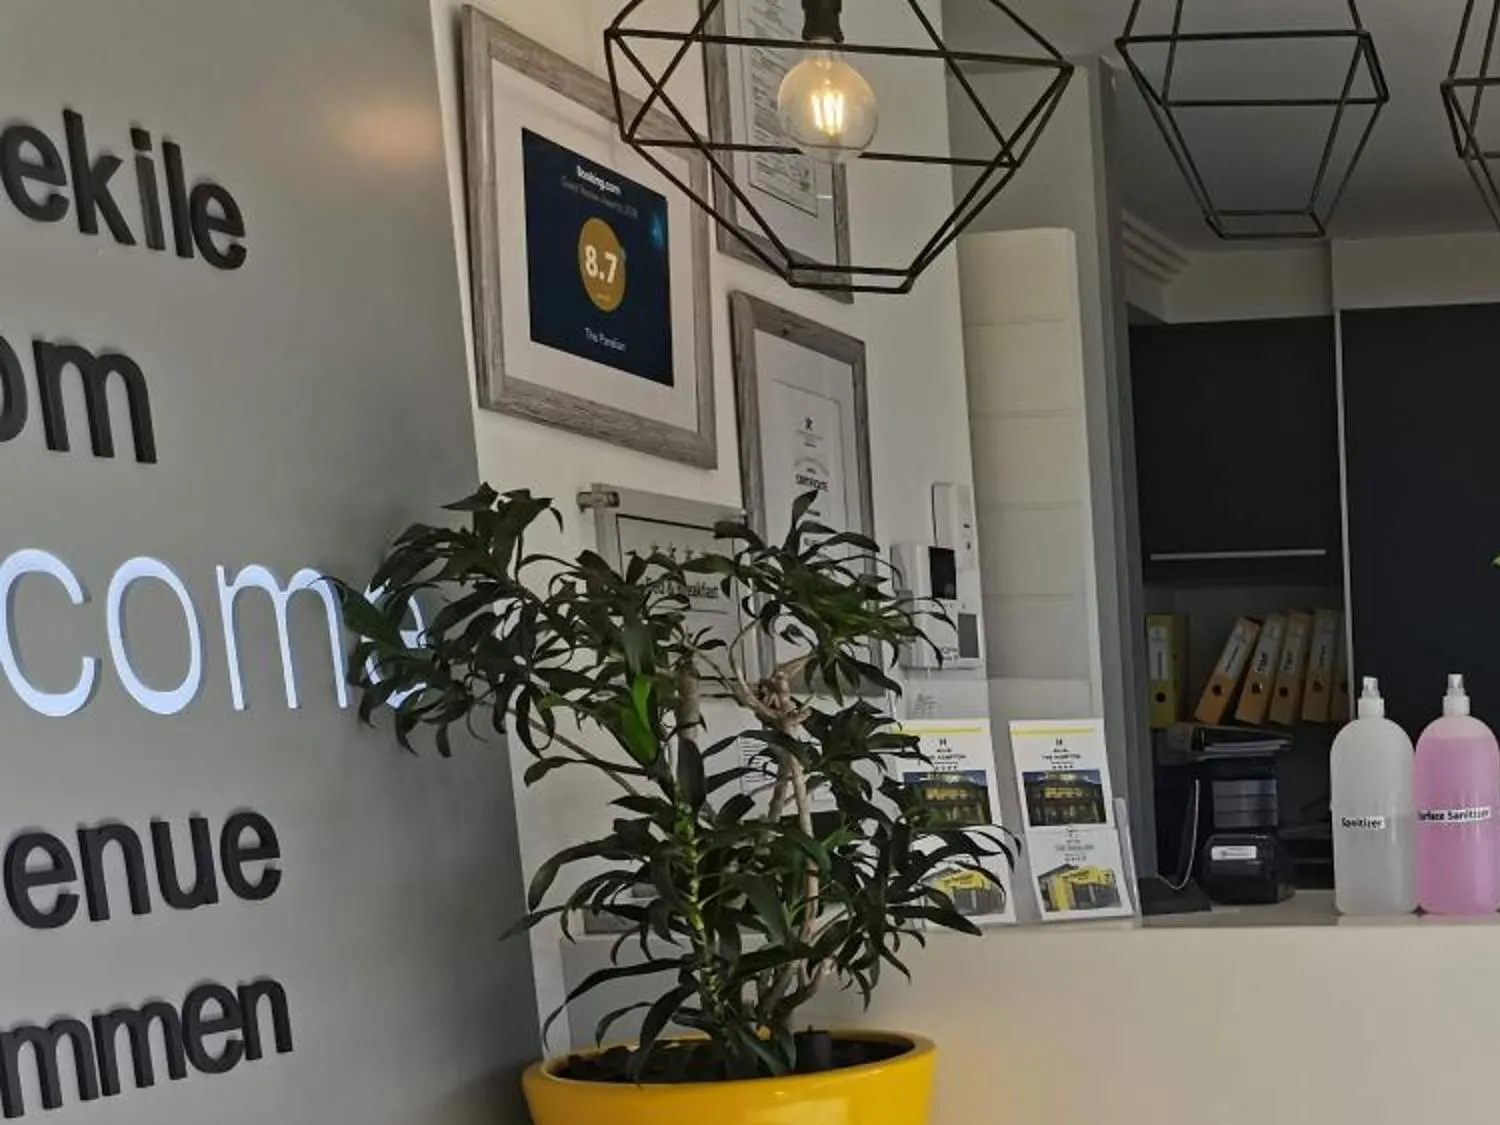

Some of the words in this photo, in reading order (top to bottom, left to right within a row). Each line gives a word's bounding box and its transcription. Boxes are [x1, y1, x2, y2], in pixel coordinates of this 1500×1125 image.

[0, 108, 248, 271] ekile
[584, 244, 618, 284] 8.7
[3, 809, 282, 929] enue
